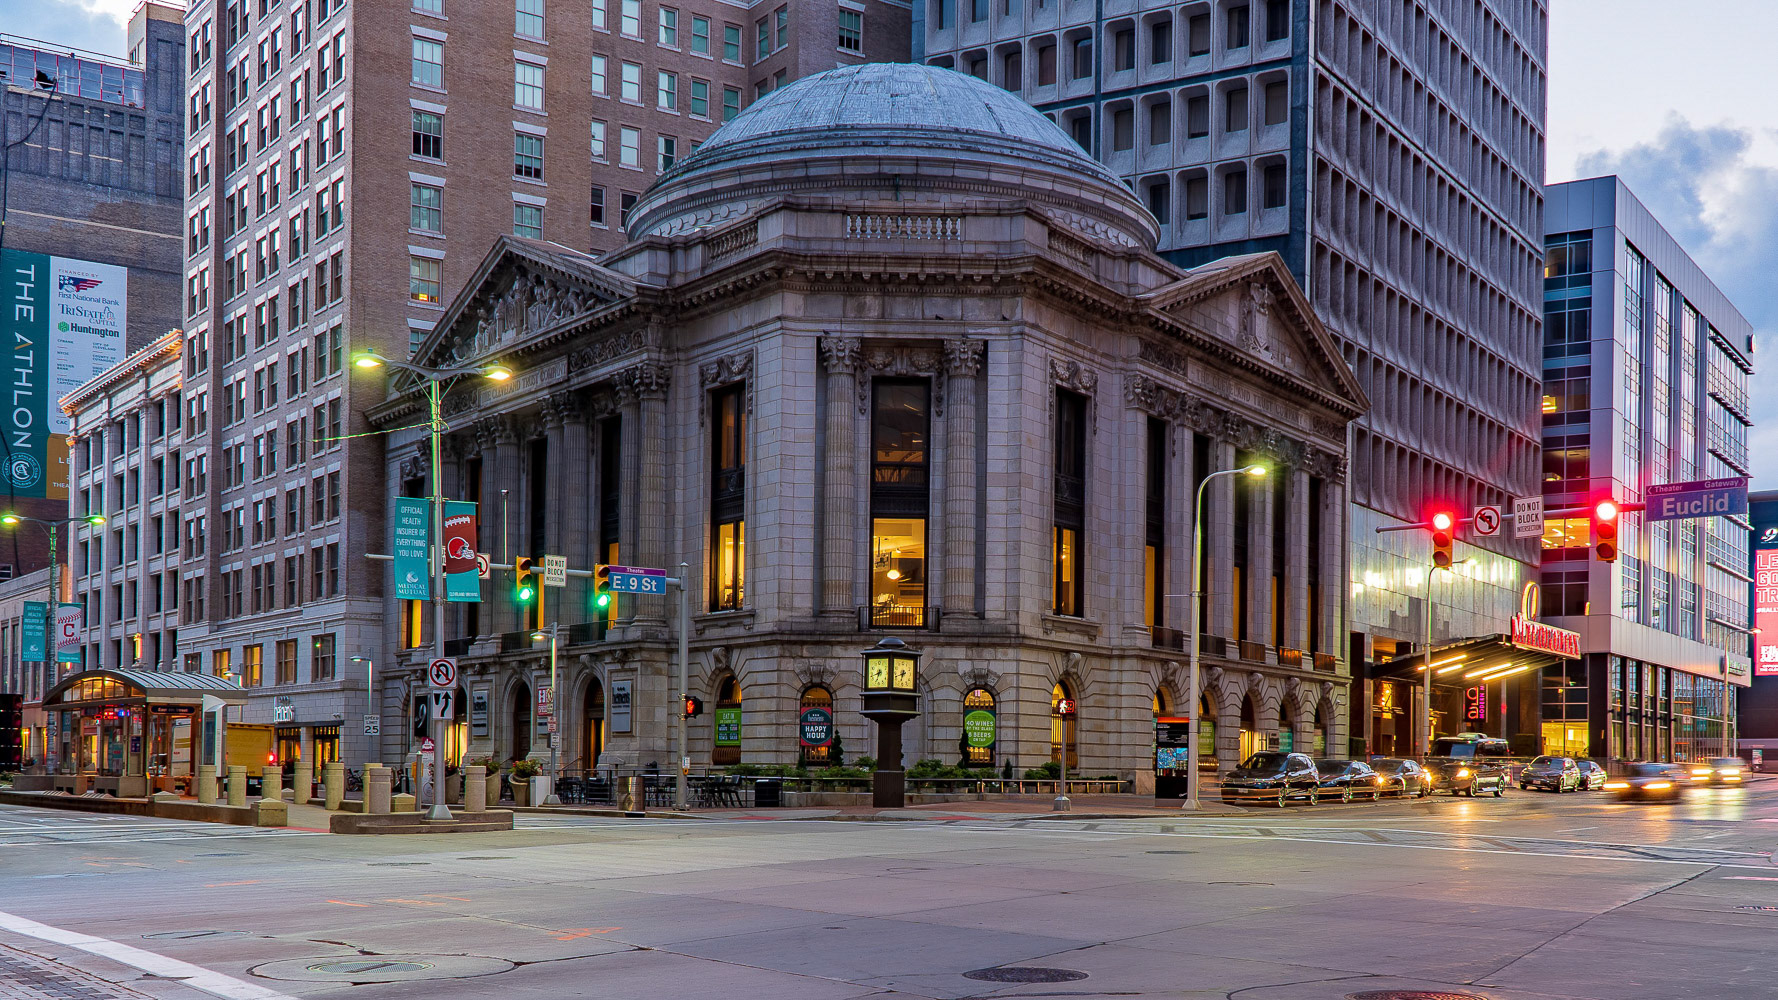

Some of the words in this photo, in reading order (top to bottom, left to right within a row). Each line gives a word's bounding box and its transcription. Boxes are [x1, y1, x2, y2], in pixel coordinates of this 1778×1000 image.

[58, 269, 89, 277] FINANCED
[15, 264, 34, 322] THE
[73, 294, 101, 304] National
[102, 298, 120, 306] Bank
[89, 319, 117, 327] CAPITAL
[70, 322, 120, 338] Huntington
[12, 331, 33, 448] ATHLON
[1655, 485, 1683, 493] Theater
[1704, 480, 1739, 489] Gateway
[1516, 503, 1526, 512] DO
[1527, 501, 1540, 511] NOT
[1662, 493, 1729, 516] Euclid
[400, 506, 423, 515] OFFICIAL
[401, 517, 421, 525] HEALTH
[1518, 513, 1540, 524] BLOCK
[396, 527, 418, 536] INSURER
[396, 538, 426, 547] EVERYTHING
[399, 549, 409, 557] YOU
[410, 550, 424, 558] LOVE
[554, 559, 565, 567] NOT
[547, 567, 564, 576] BLOCK
[613, 575, 625, 589] E.
[629, 577, 638, 590] 9
[641, 577, 657, 592] St
[63, 623, 75, 637] C
[722, 712, 730, 720] EAT
[364, 725, 379, 734] 25
